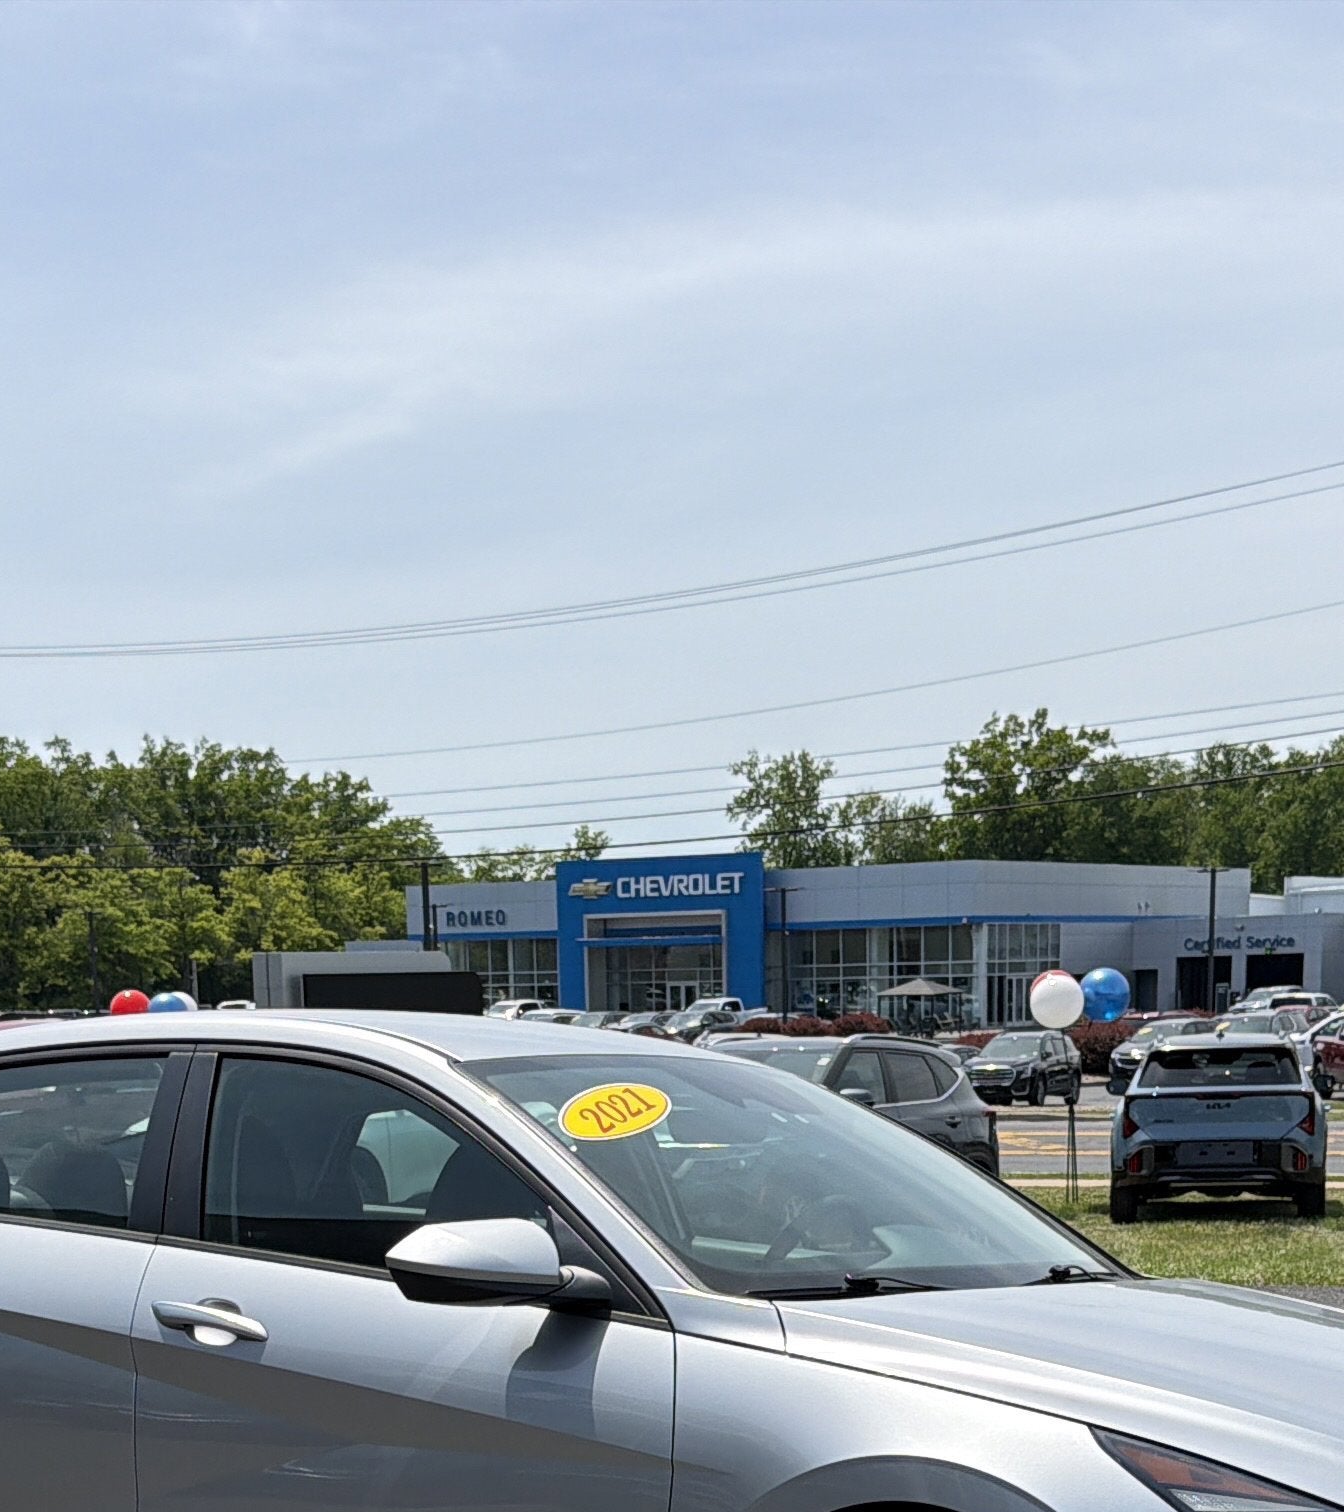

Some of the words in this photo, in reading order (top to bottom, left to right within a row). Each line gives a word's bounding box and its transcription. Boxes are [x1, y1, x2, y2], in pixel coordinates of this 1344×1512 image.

[616, 872, 744, 898] CHEVROLET
[446, 909, 506, 927] ROMEO
[1246, 935, 1295, 951] Service
[579, 1087, 657, 1134] 2021
